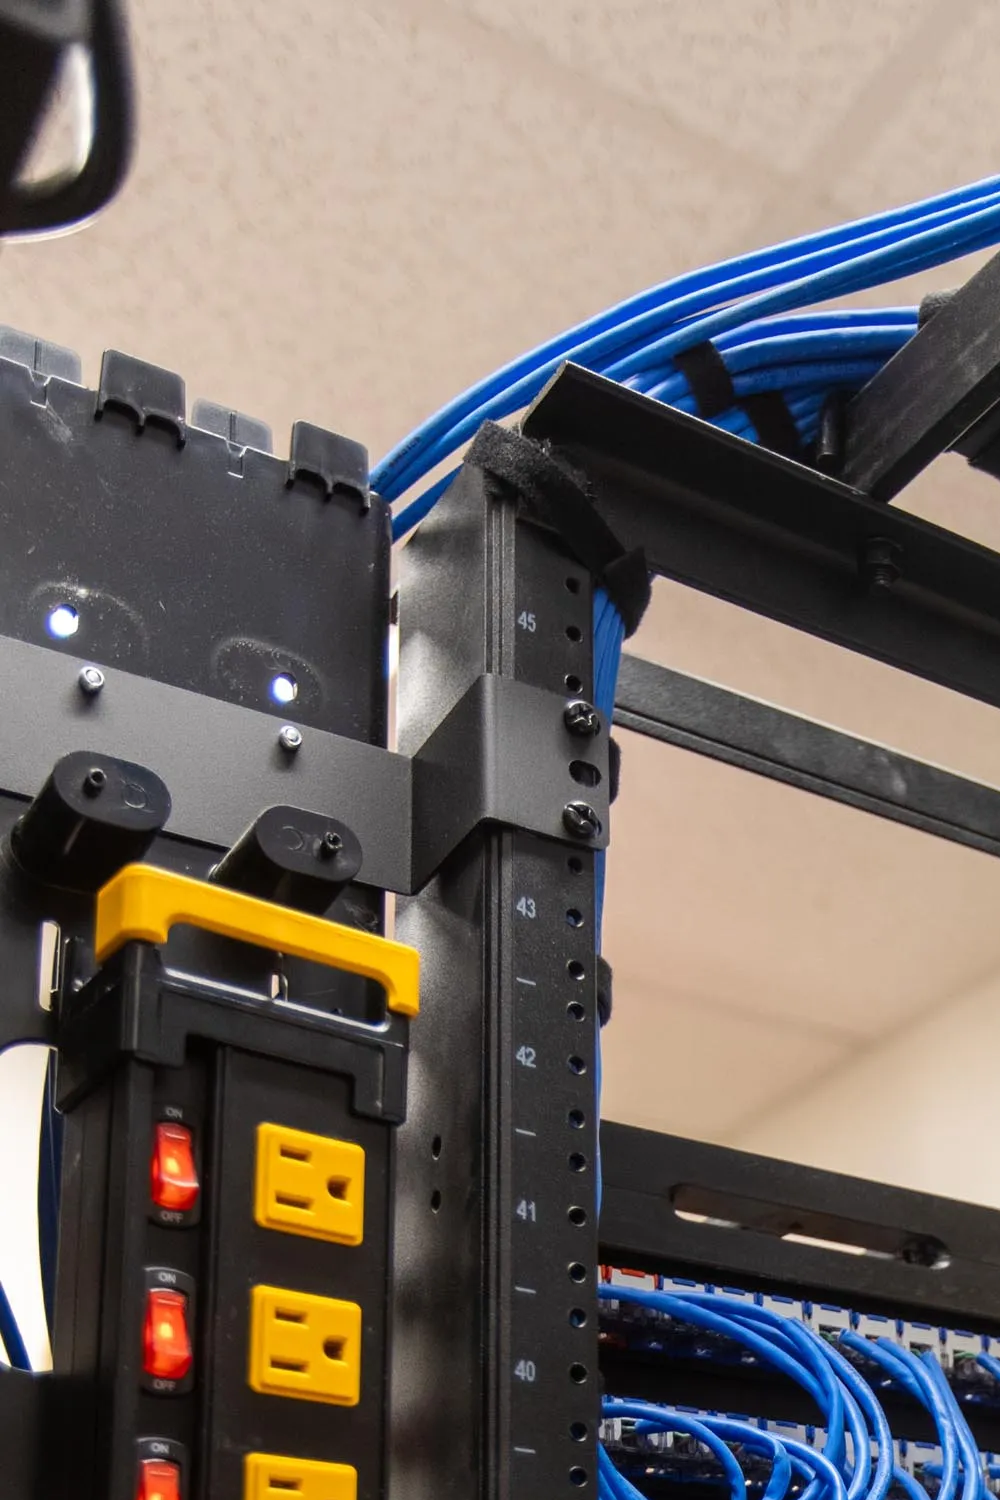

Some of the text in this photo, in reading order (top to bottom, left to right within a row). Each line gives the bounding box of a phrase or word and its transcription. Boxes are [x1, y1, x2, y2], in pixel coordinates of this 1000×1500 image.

[517, 611, 537, 632] 45
[516, 896, 536, 919] 43
[516, 1046, 536, 1068] 42
[166, 1107, 183, 1119] ON
[161, 1211, 182, 1222] OFF
[516, 1200, 536, 1222] 41
[159, 1272, 176, 1283] ON
[515, 1360, 535, 1381] 40
[154, 1380, 175, 1391] OFF
[152, 1443, 169, 1454] ON
